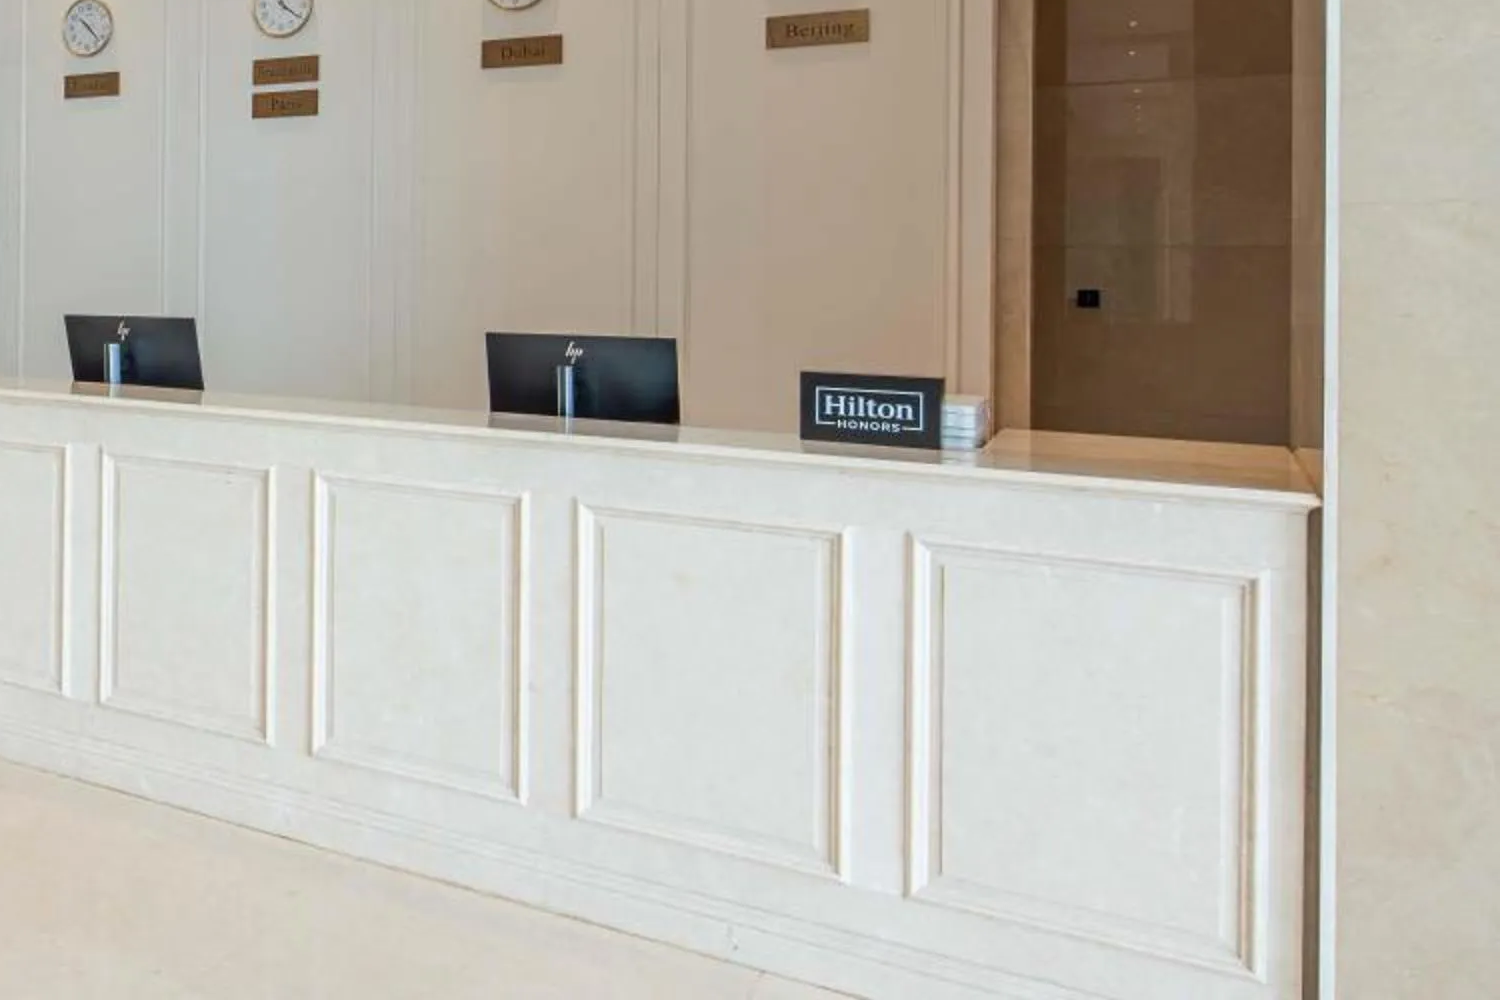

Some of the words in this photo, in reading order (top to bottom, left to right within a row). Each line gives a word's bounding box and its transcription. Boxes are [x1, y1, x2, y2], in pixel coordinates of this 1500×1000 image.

[785, 19, 854, 40] Beijing
[564, 340, 584, 365] hp
[823, 394, 915, 421] Hilton
[836, 419, 902, 433] HONORS
